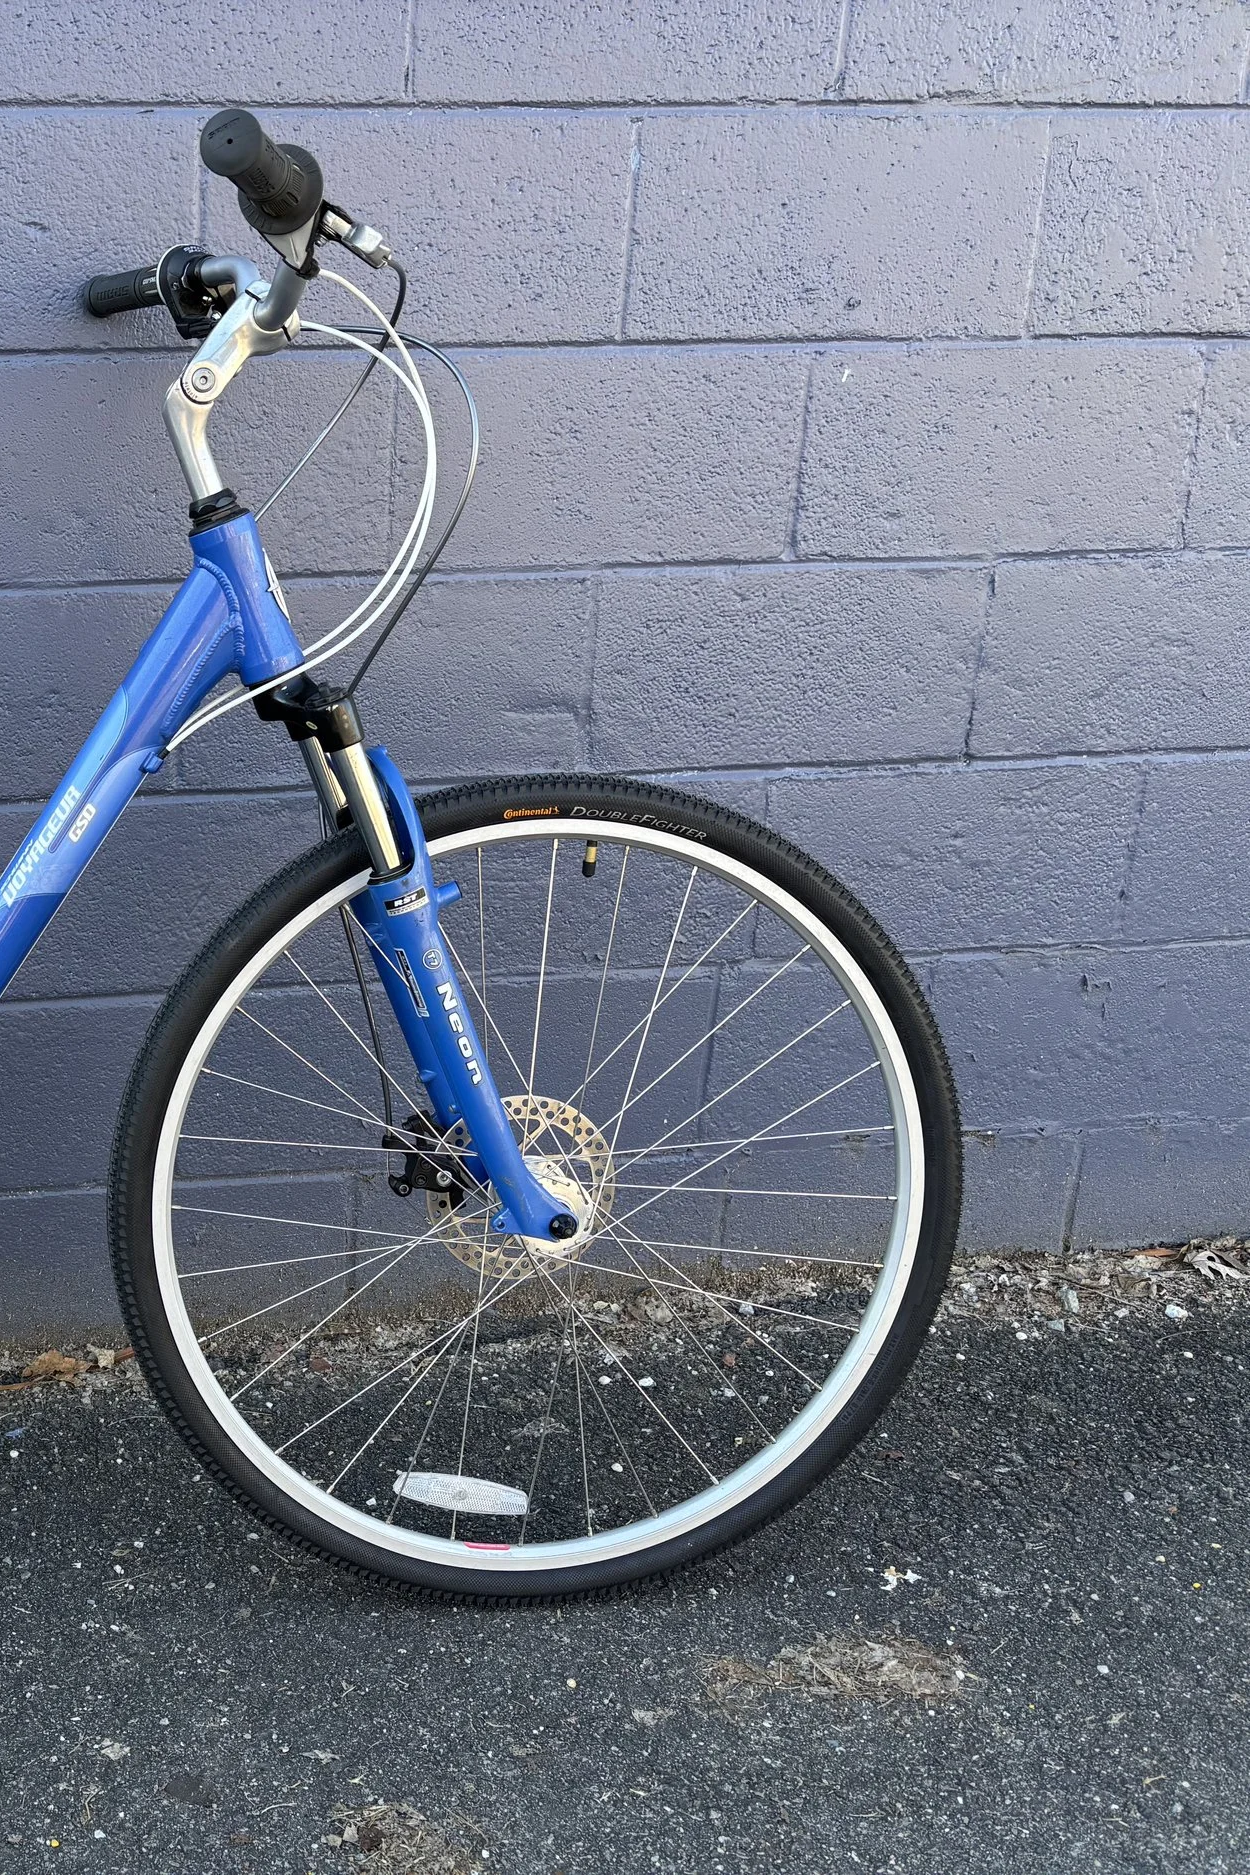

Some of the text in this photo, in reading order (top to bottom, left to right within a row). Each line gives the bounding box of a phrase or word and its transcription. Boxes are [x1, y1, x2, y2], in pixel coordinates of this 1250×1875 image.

[502, 806, 553, 819] Continental
[393, 893, 418, 908] RST
[436, 982, 483, 1086] Neon
